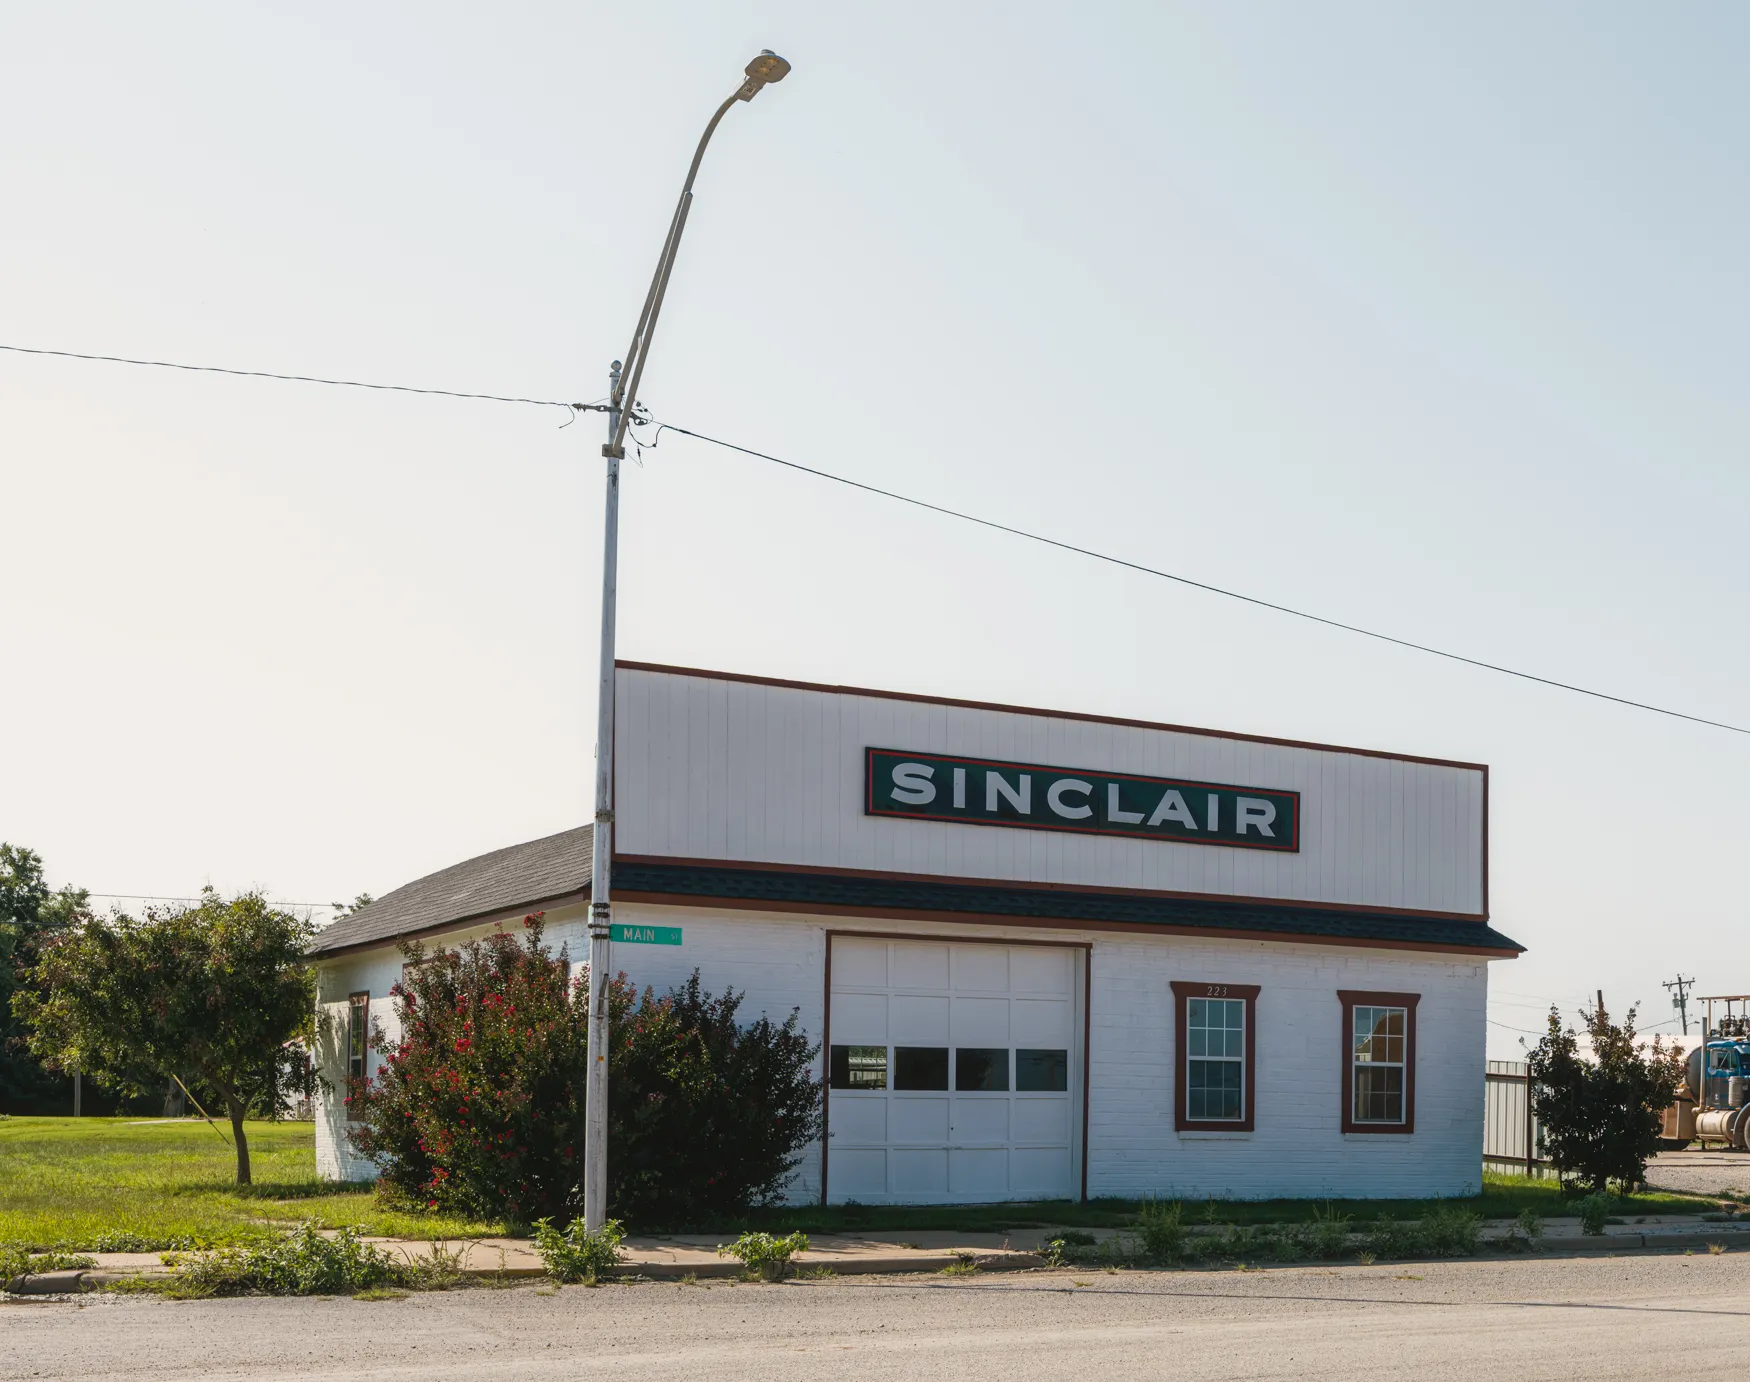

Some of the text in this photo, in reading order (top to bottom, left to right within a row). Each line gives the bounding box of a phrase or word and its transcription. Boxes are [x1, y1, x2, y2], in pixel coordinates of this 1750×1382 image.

[890, 762, 1277, 837] SINCLAIR
[623, 927, 655, 941] MAIN
[1207, 985, 1227, 997] 223
